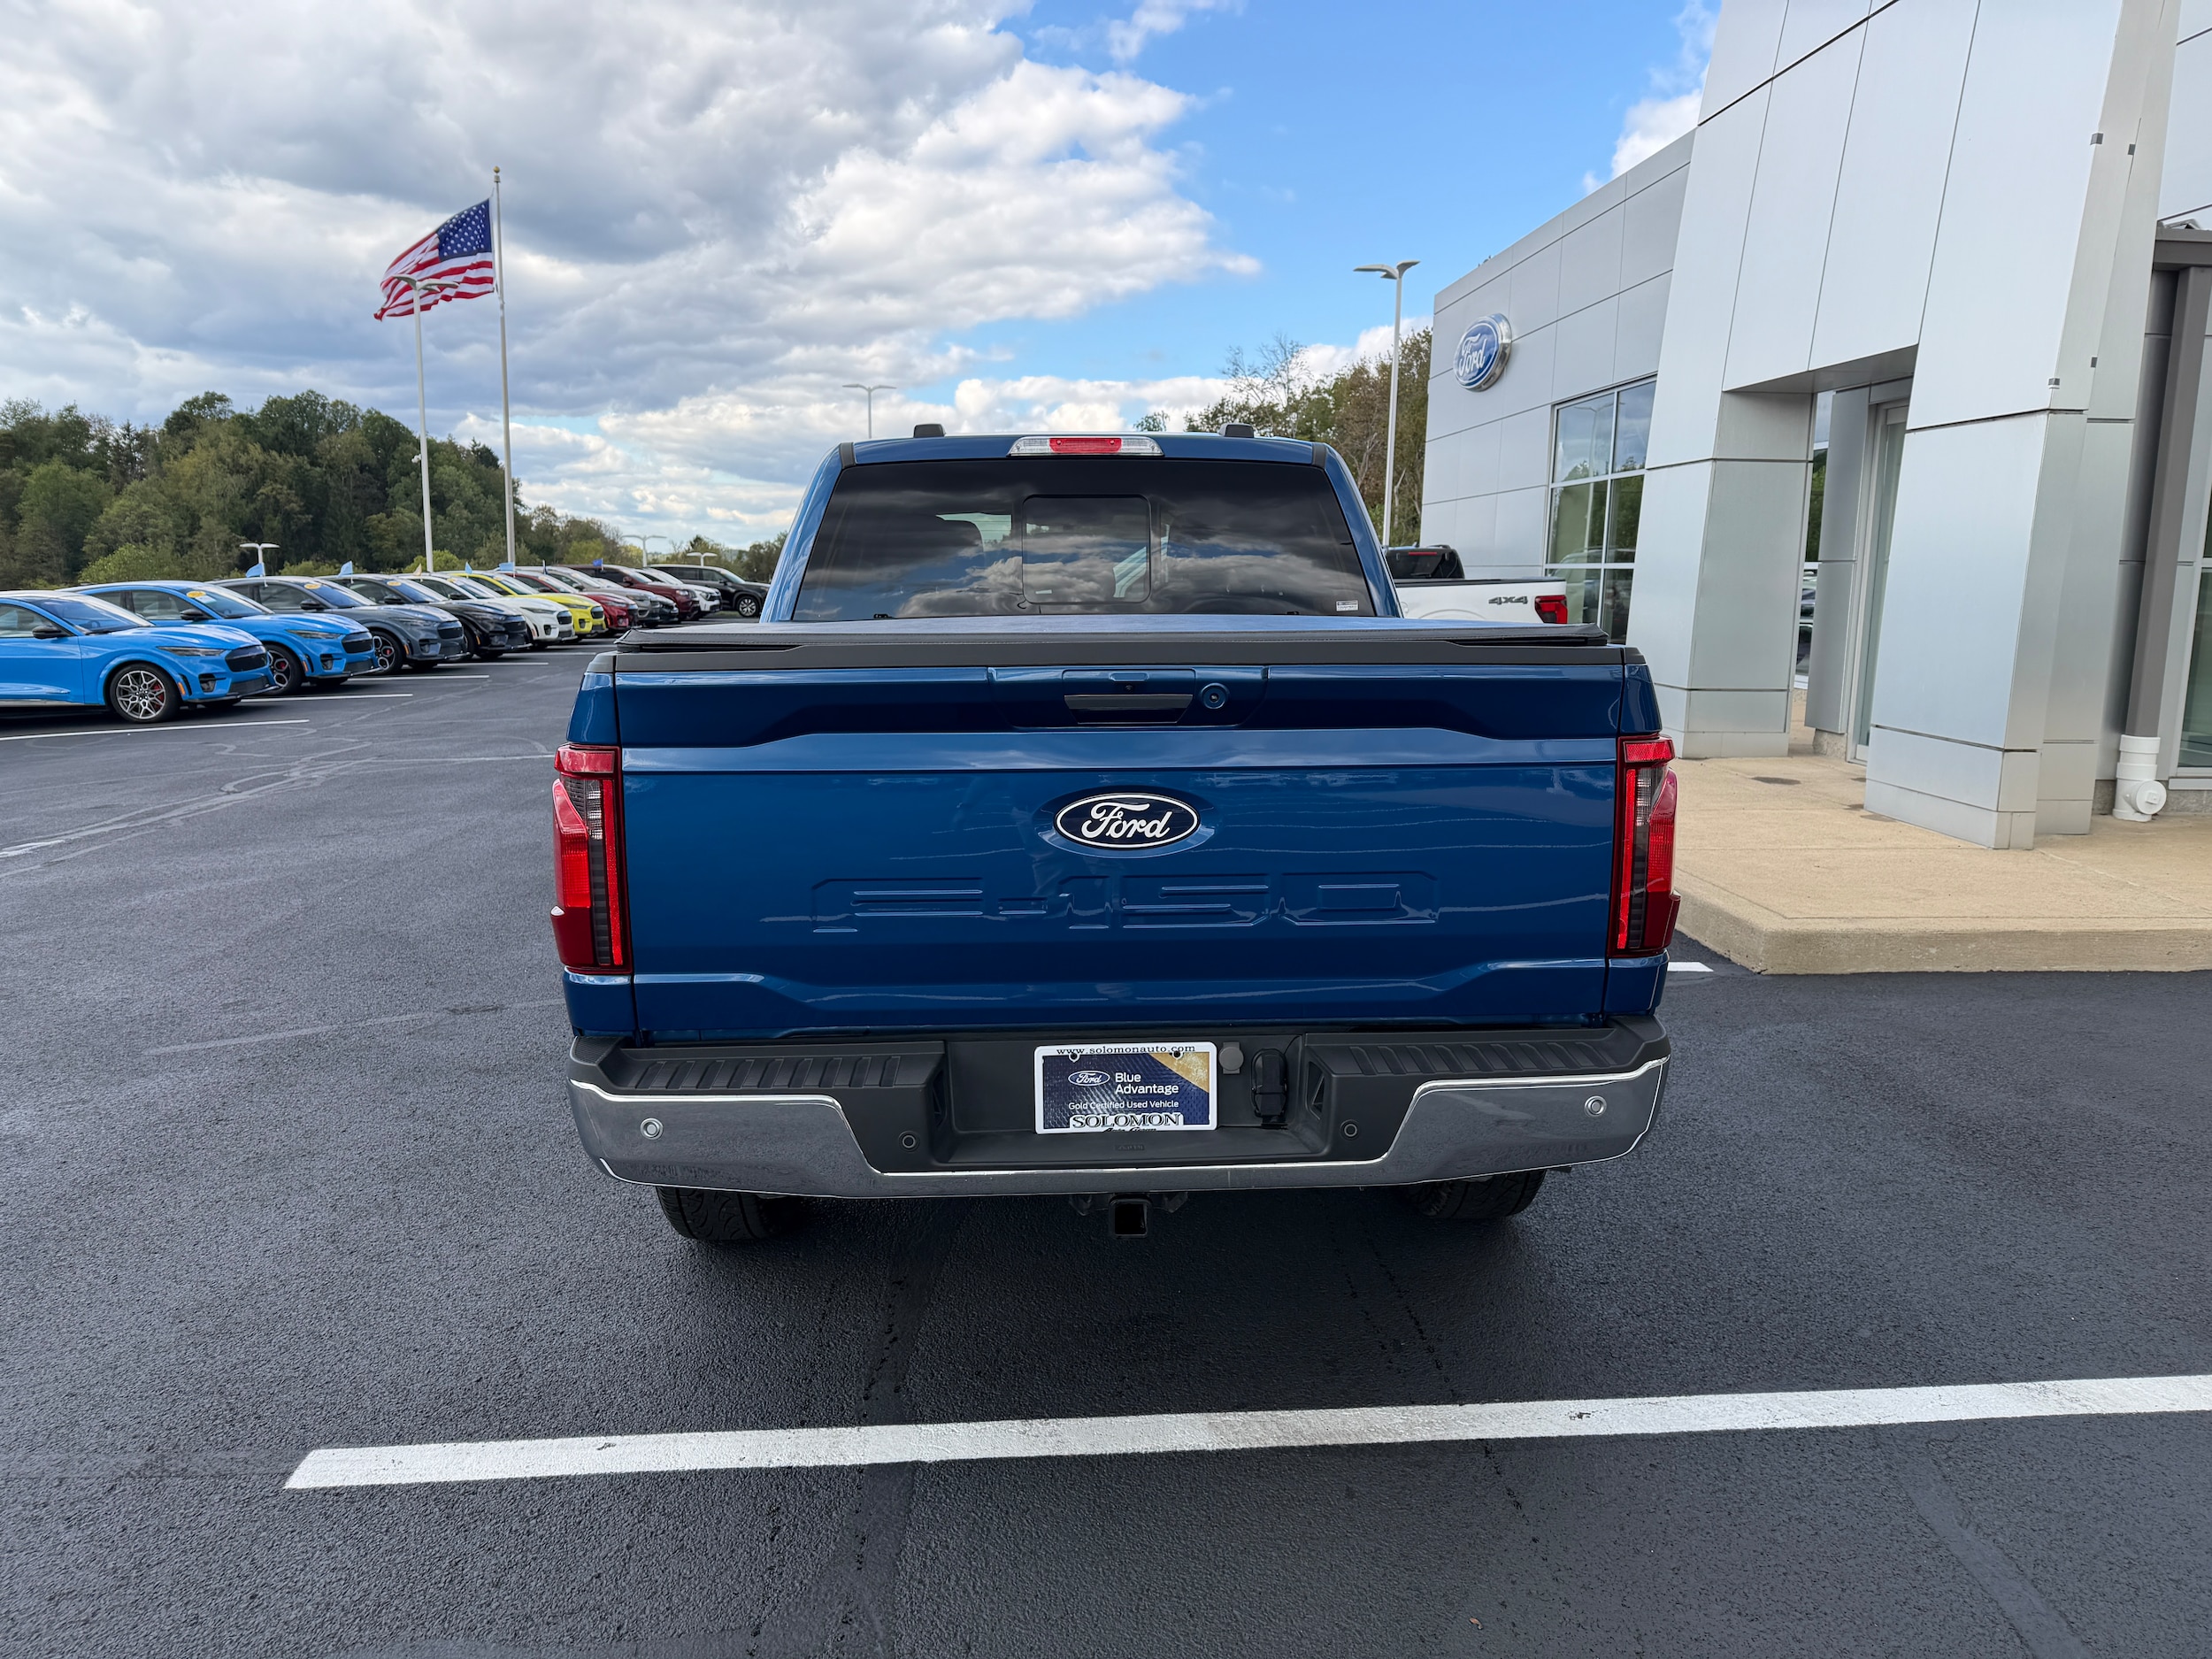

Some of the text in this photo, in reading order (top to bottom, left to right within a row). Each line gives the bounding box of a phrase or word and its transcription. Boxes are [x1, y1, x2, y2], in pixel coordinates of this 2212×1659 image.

[1458, 333, 1487, 377] Ford
[1081, 802, 1173, 839] Ford
[1056, 1046, 1196, 1055] www.solomonauto.com
[1076, 1072, 1102, 1084] Ford
[1115, 1072, 1141, 1083] Blue
[1115, 1084, 1179, 1095] Advantage
[1068, 1102, 1088, 1110] Gold
[1089, 1101, 1125, 1110] Certified
[1149, 1099, 1179, 1108] Vehicle
[1072, 1113, 1180, 1128] SOLOMON
